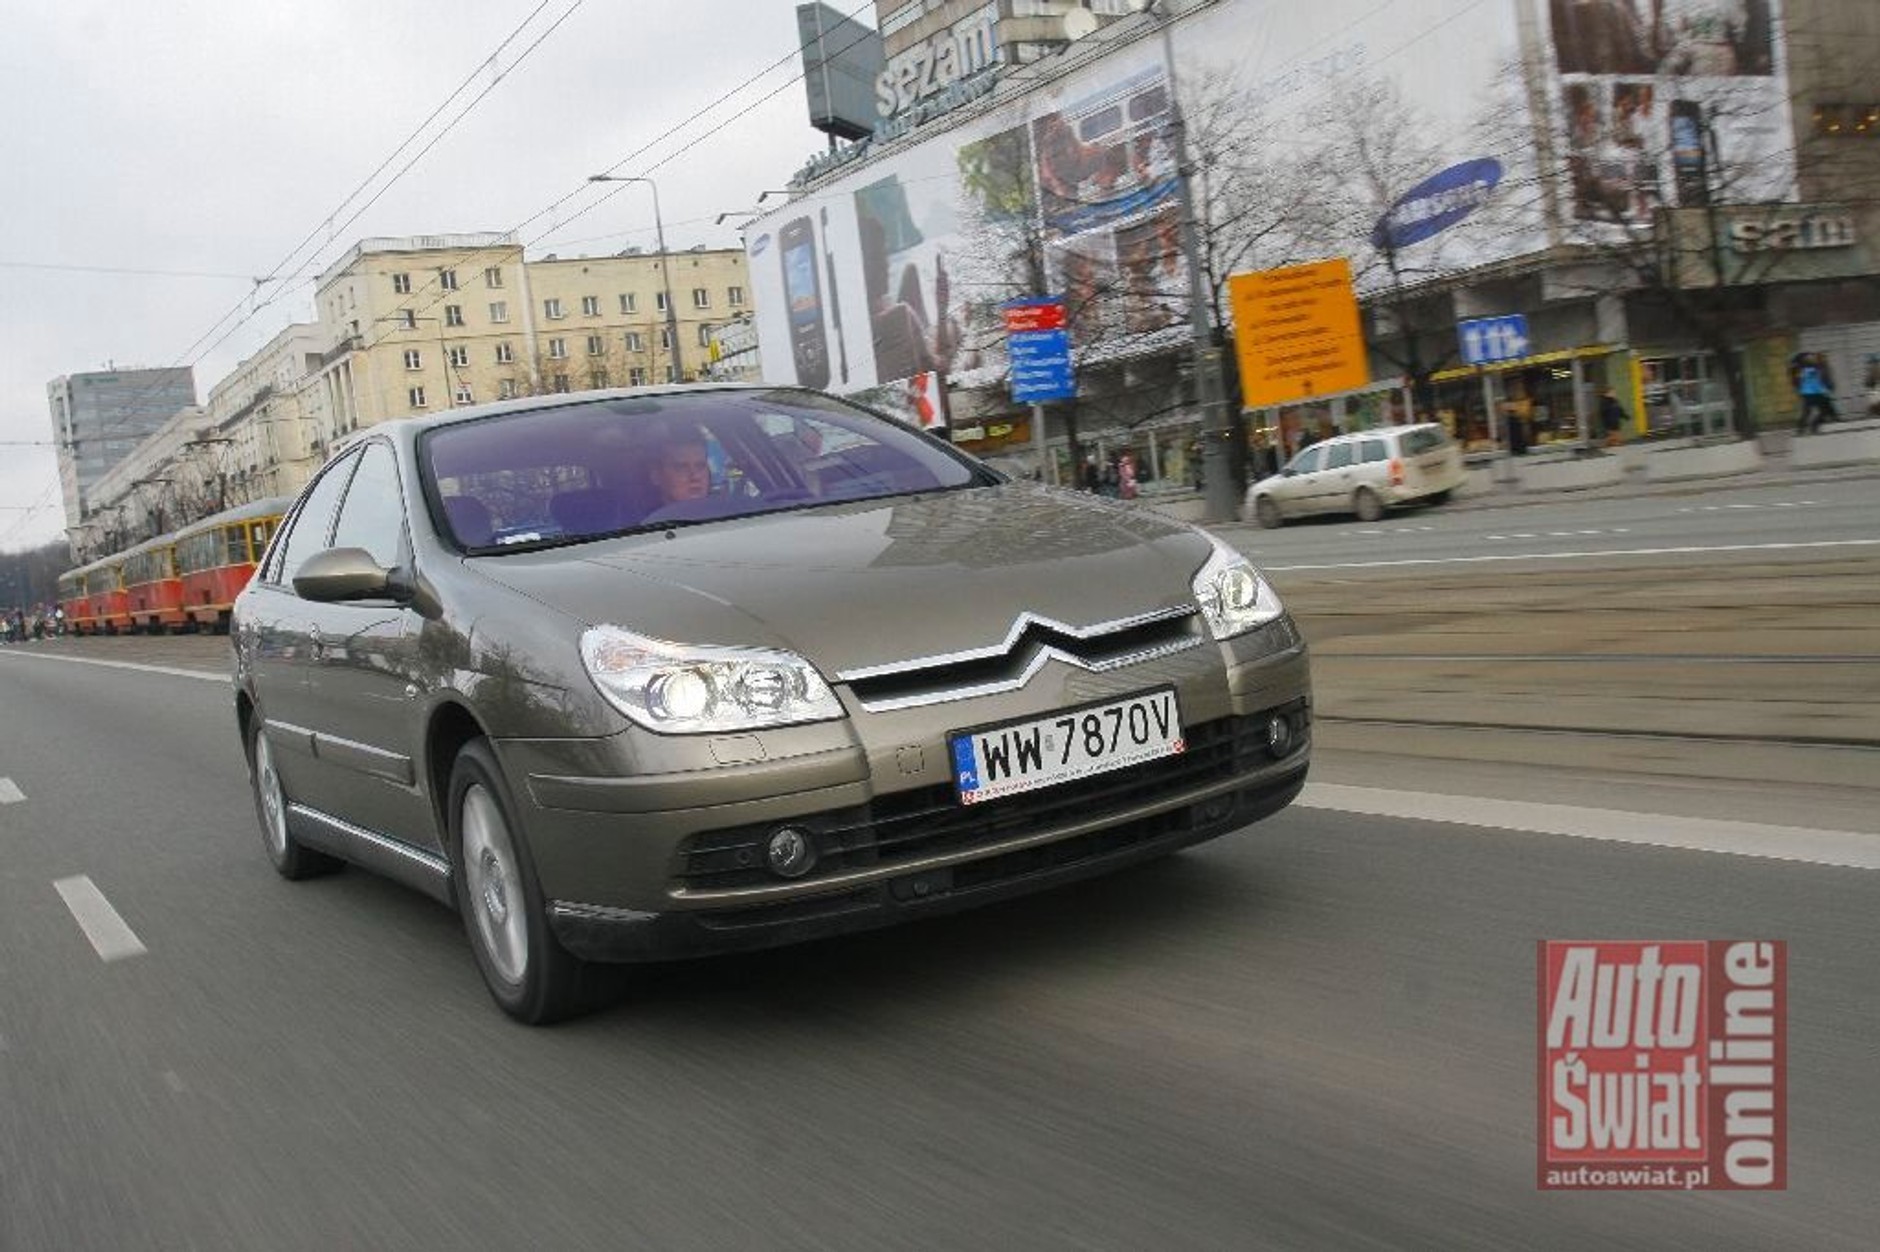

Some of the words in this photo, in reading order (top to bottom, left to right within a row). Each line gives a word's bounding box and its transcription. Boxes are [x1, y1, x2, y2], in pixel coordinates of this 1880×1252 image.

[876, 17, 996, 117] sezam
[960, 771, 976, 784] PL
[981, 727, 1042, 781] WW
[1056, 696, 1169, 765] 7870V
